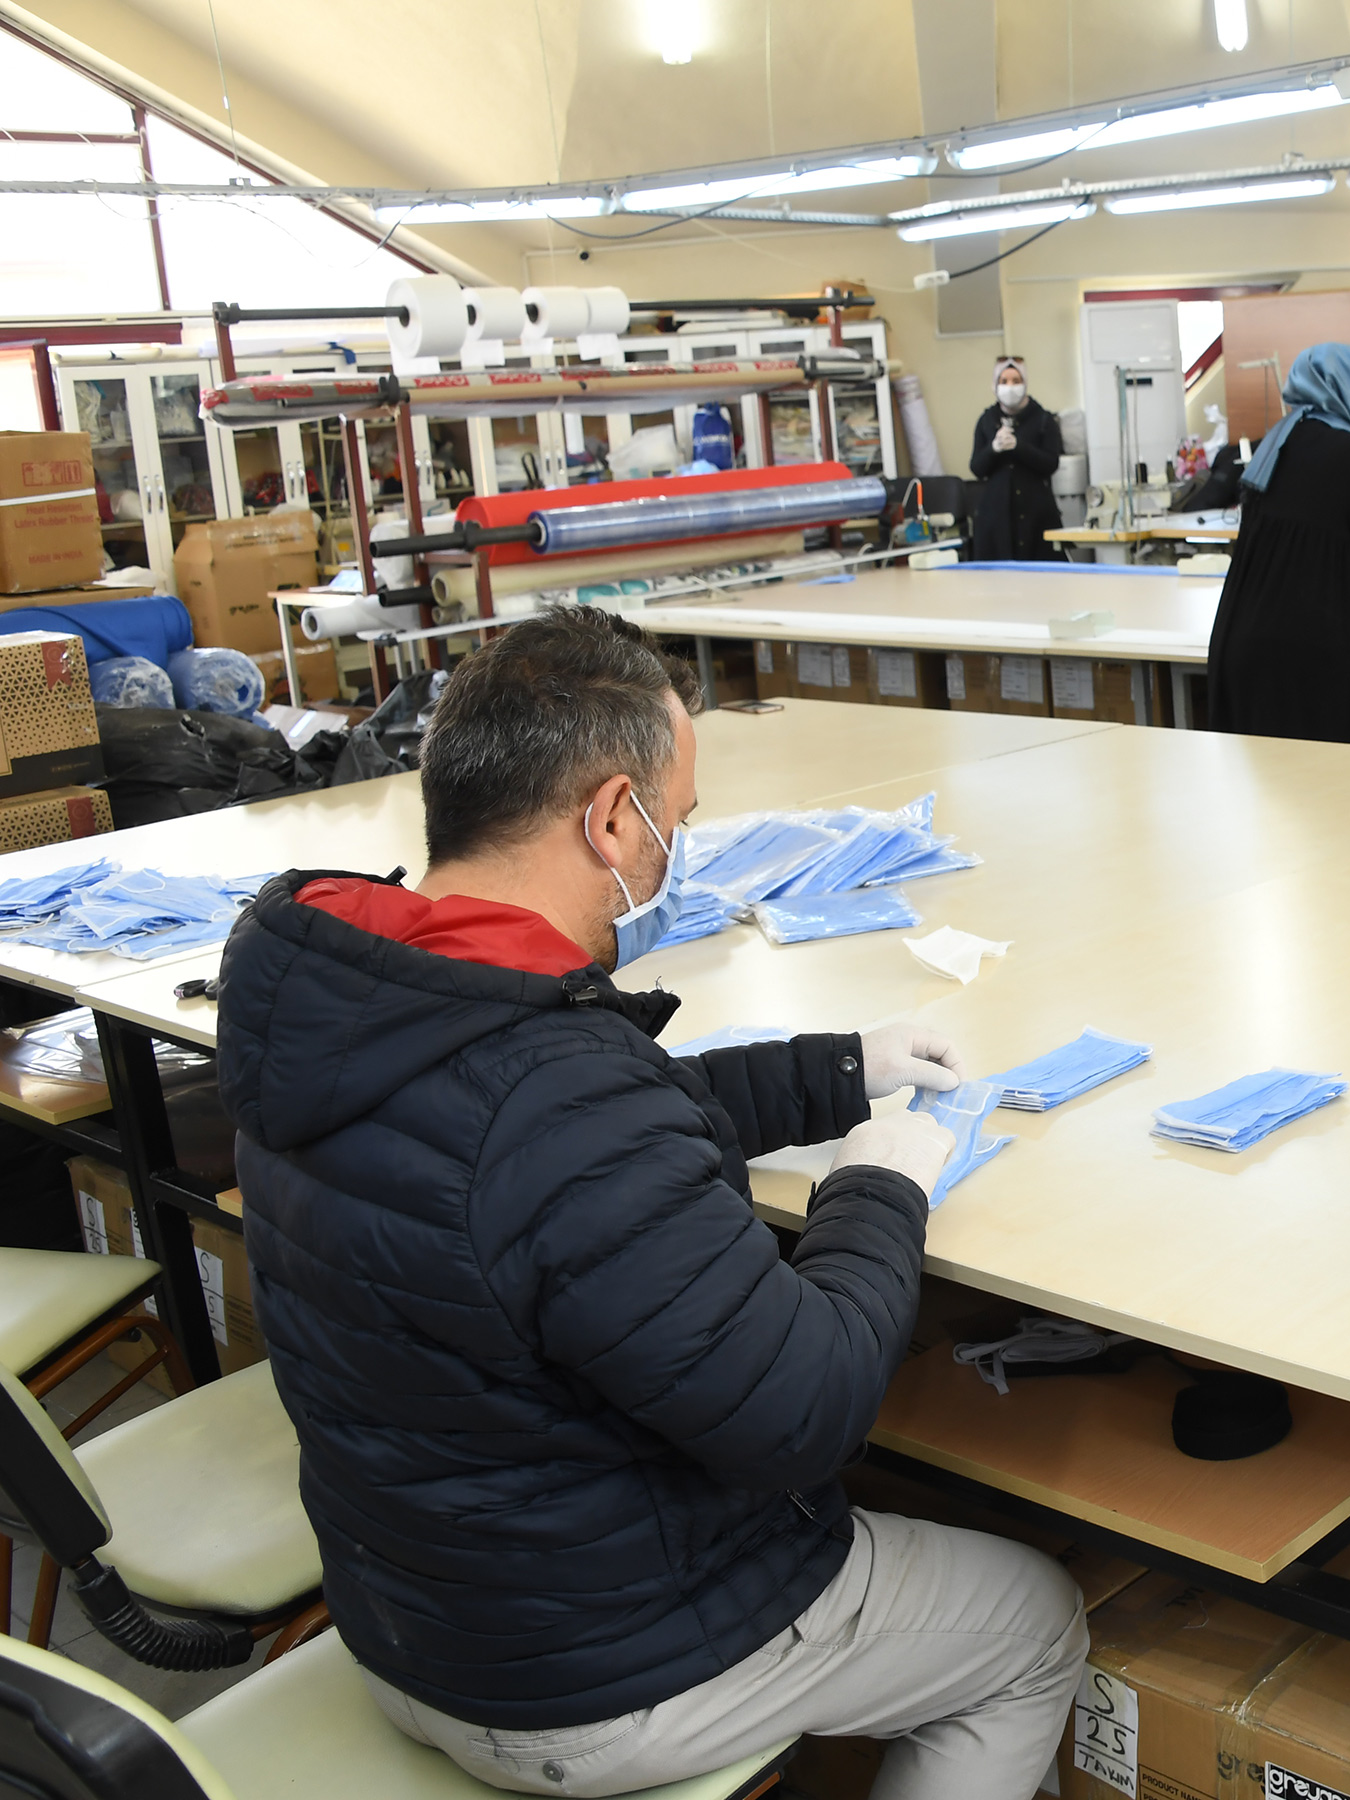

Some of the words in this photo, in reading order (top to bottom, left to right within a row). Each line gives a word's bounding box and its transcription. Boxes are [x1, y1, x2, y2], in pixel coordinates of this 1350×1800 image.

[1093, 1672, 1116, 1715] S
[1086, 1715, 1128, 1756] 25
[1142, 1773, 1179, 1796] PRODUCT
